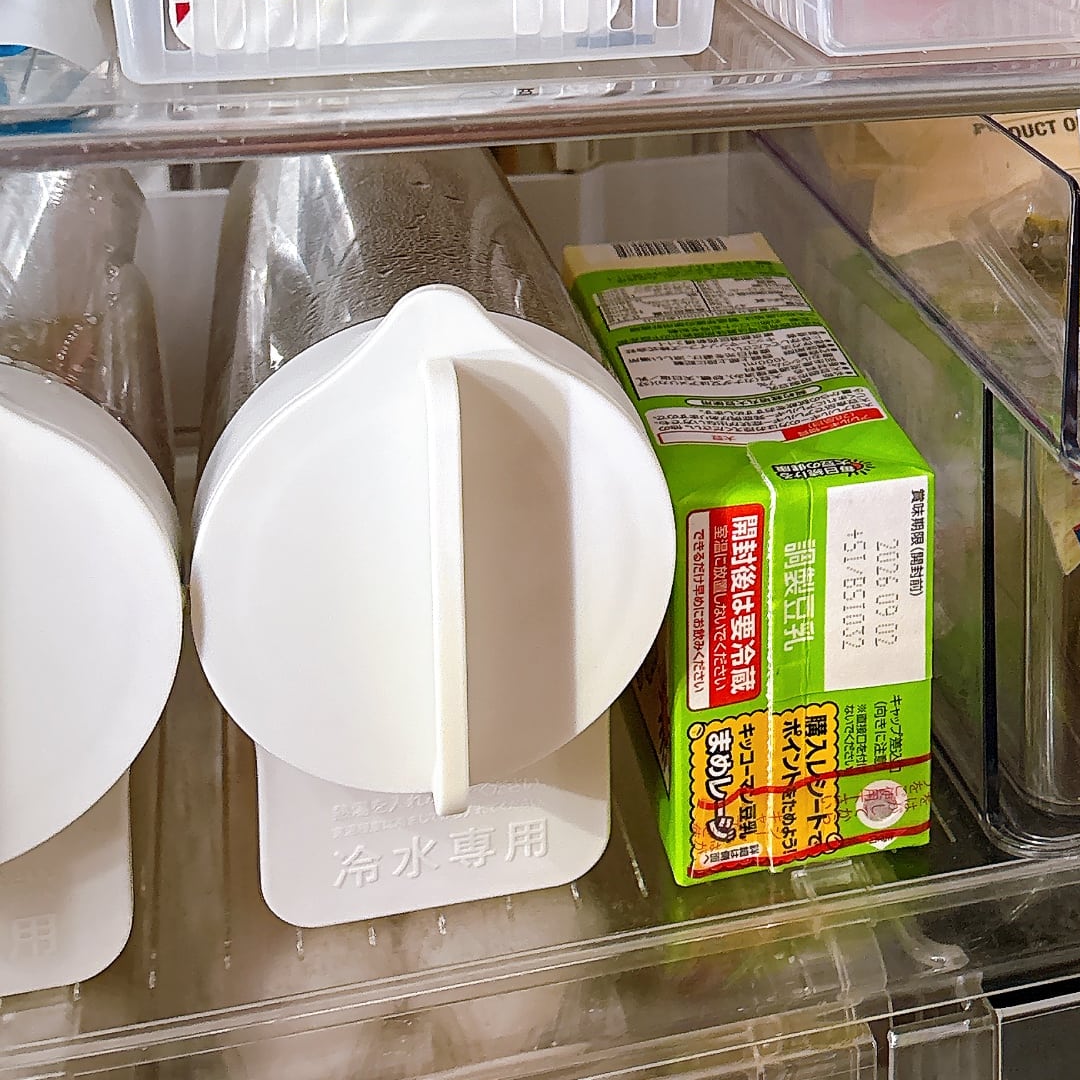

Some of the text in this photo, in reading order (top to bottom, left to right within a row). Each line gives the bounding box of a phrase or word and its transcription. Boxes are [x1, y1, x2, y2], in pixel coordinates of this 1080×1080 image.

[783, 538, 817, 652] 調製豆乳
[909, 488, 926, 597] 賞味期限(開封前)
[692, 529, 705, 693] できるだけ早めにお飲みください
[713, 525, 728, 691] 室温に放置しないでください
[730, 514, 758, 694] 開封後は要冷蔵
[705, 728, 737, 842] まめレージ
[332, 817, 550, 890] 冷水専用
